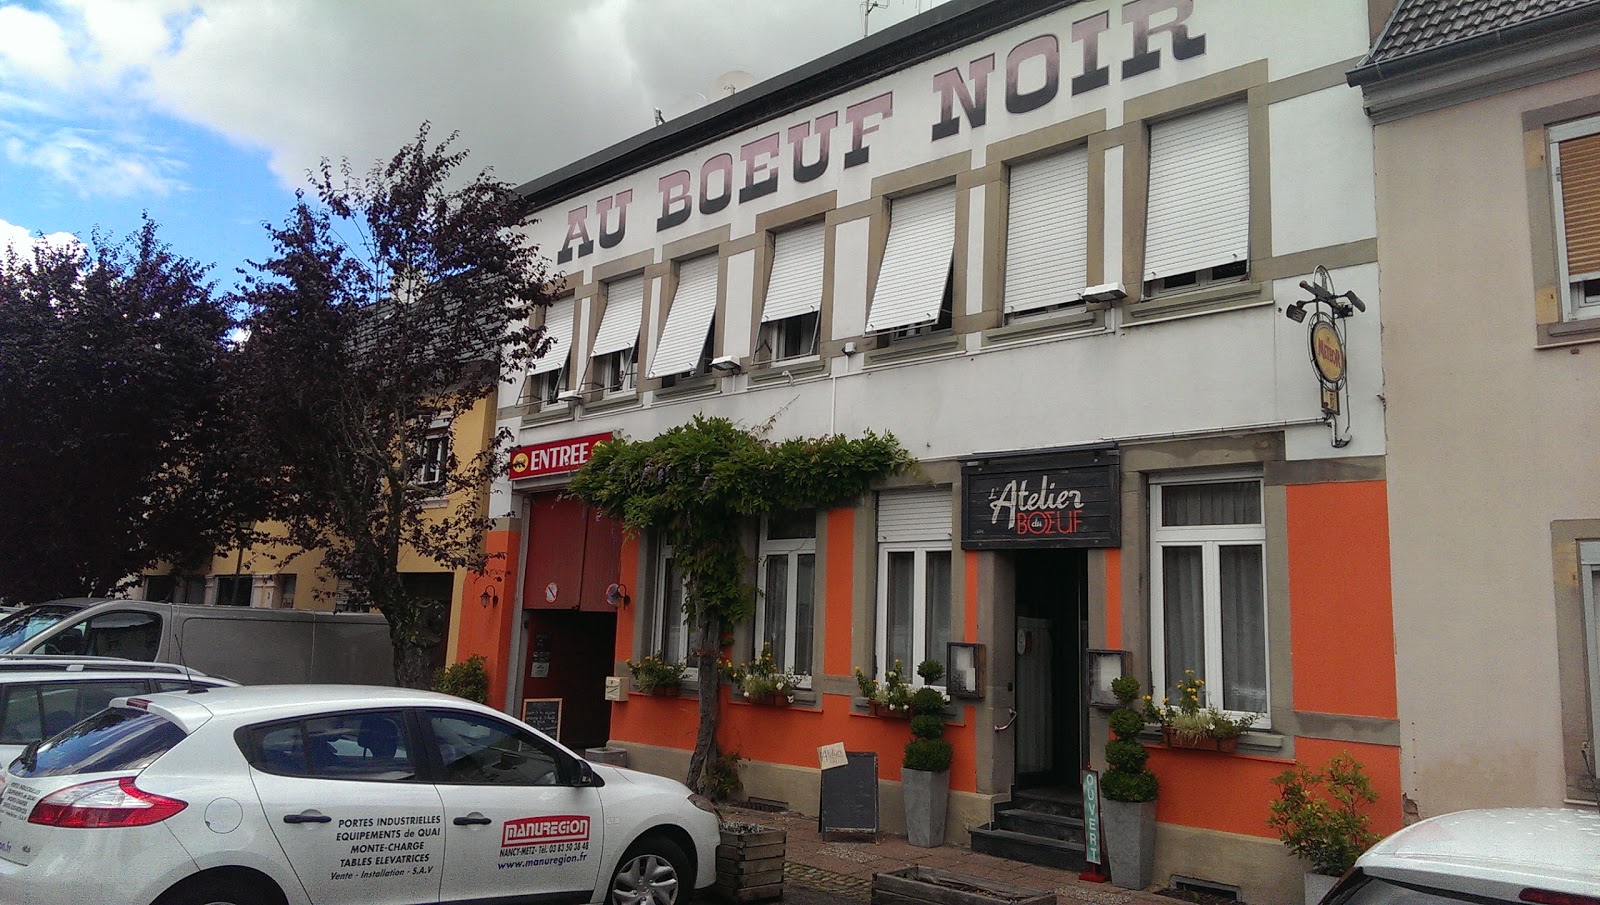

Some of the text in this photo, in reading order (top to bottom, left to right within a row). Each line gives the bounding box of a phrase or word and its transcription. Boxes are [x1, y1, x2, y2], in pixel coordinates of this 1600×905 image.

[557, 0, 1206, 264] AU BOEUF NOIR
[530, 442, 589, 471] ENTREE
[1031, 517, 1043, 528] du
[338, 815, 441, 828] PORTES INDUSTRIELLES
[1086, 774, 1097, 860] OUVERT
[336, 828, 441, 841] EQUIPEMENTS de QUAI
[350, 842, 425, 854] MONTE-CHARGE
[340, 853, 430, 868] TABLES ELEVATRICES
[497, 852, 588, 870] www.manuregion.fr
[330, 871, 354, 881] Vente
[361, 867, 404, 879] Installation
